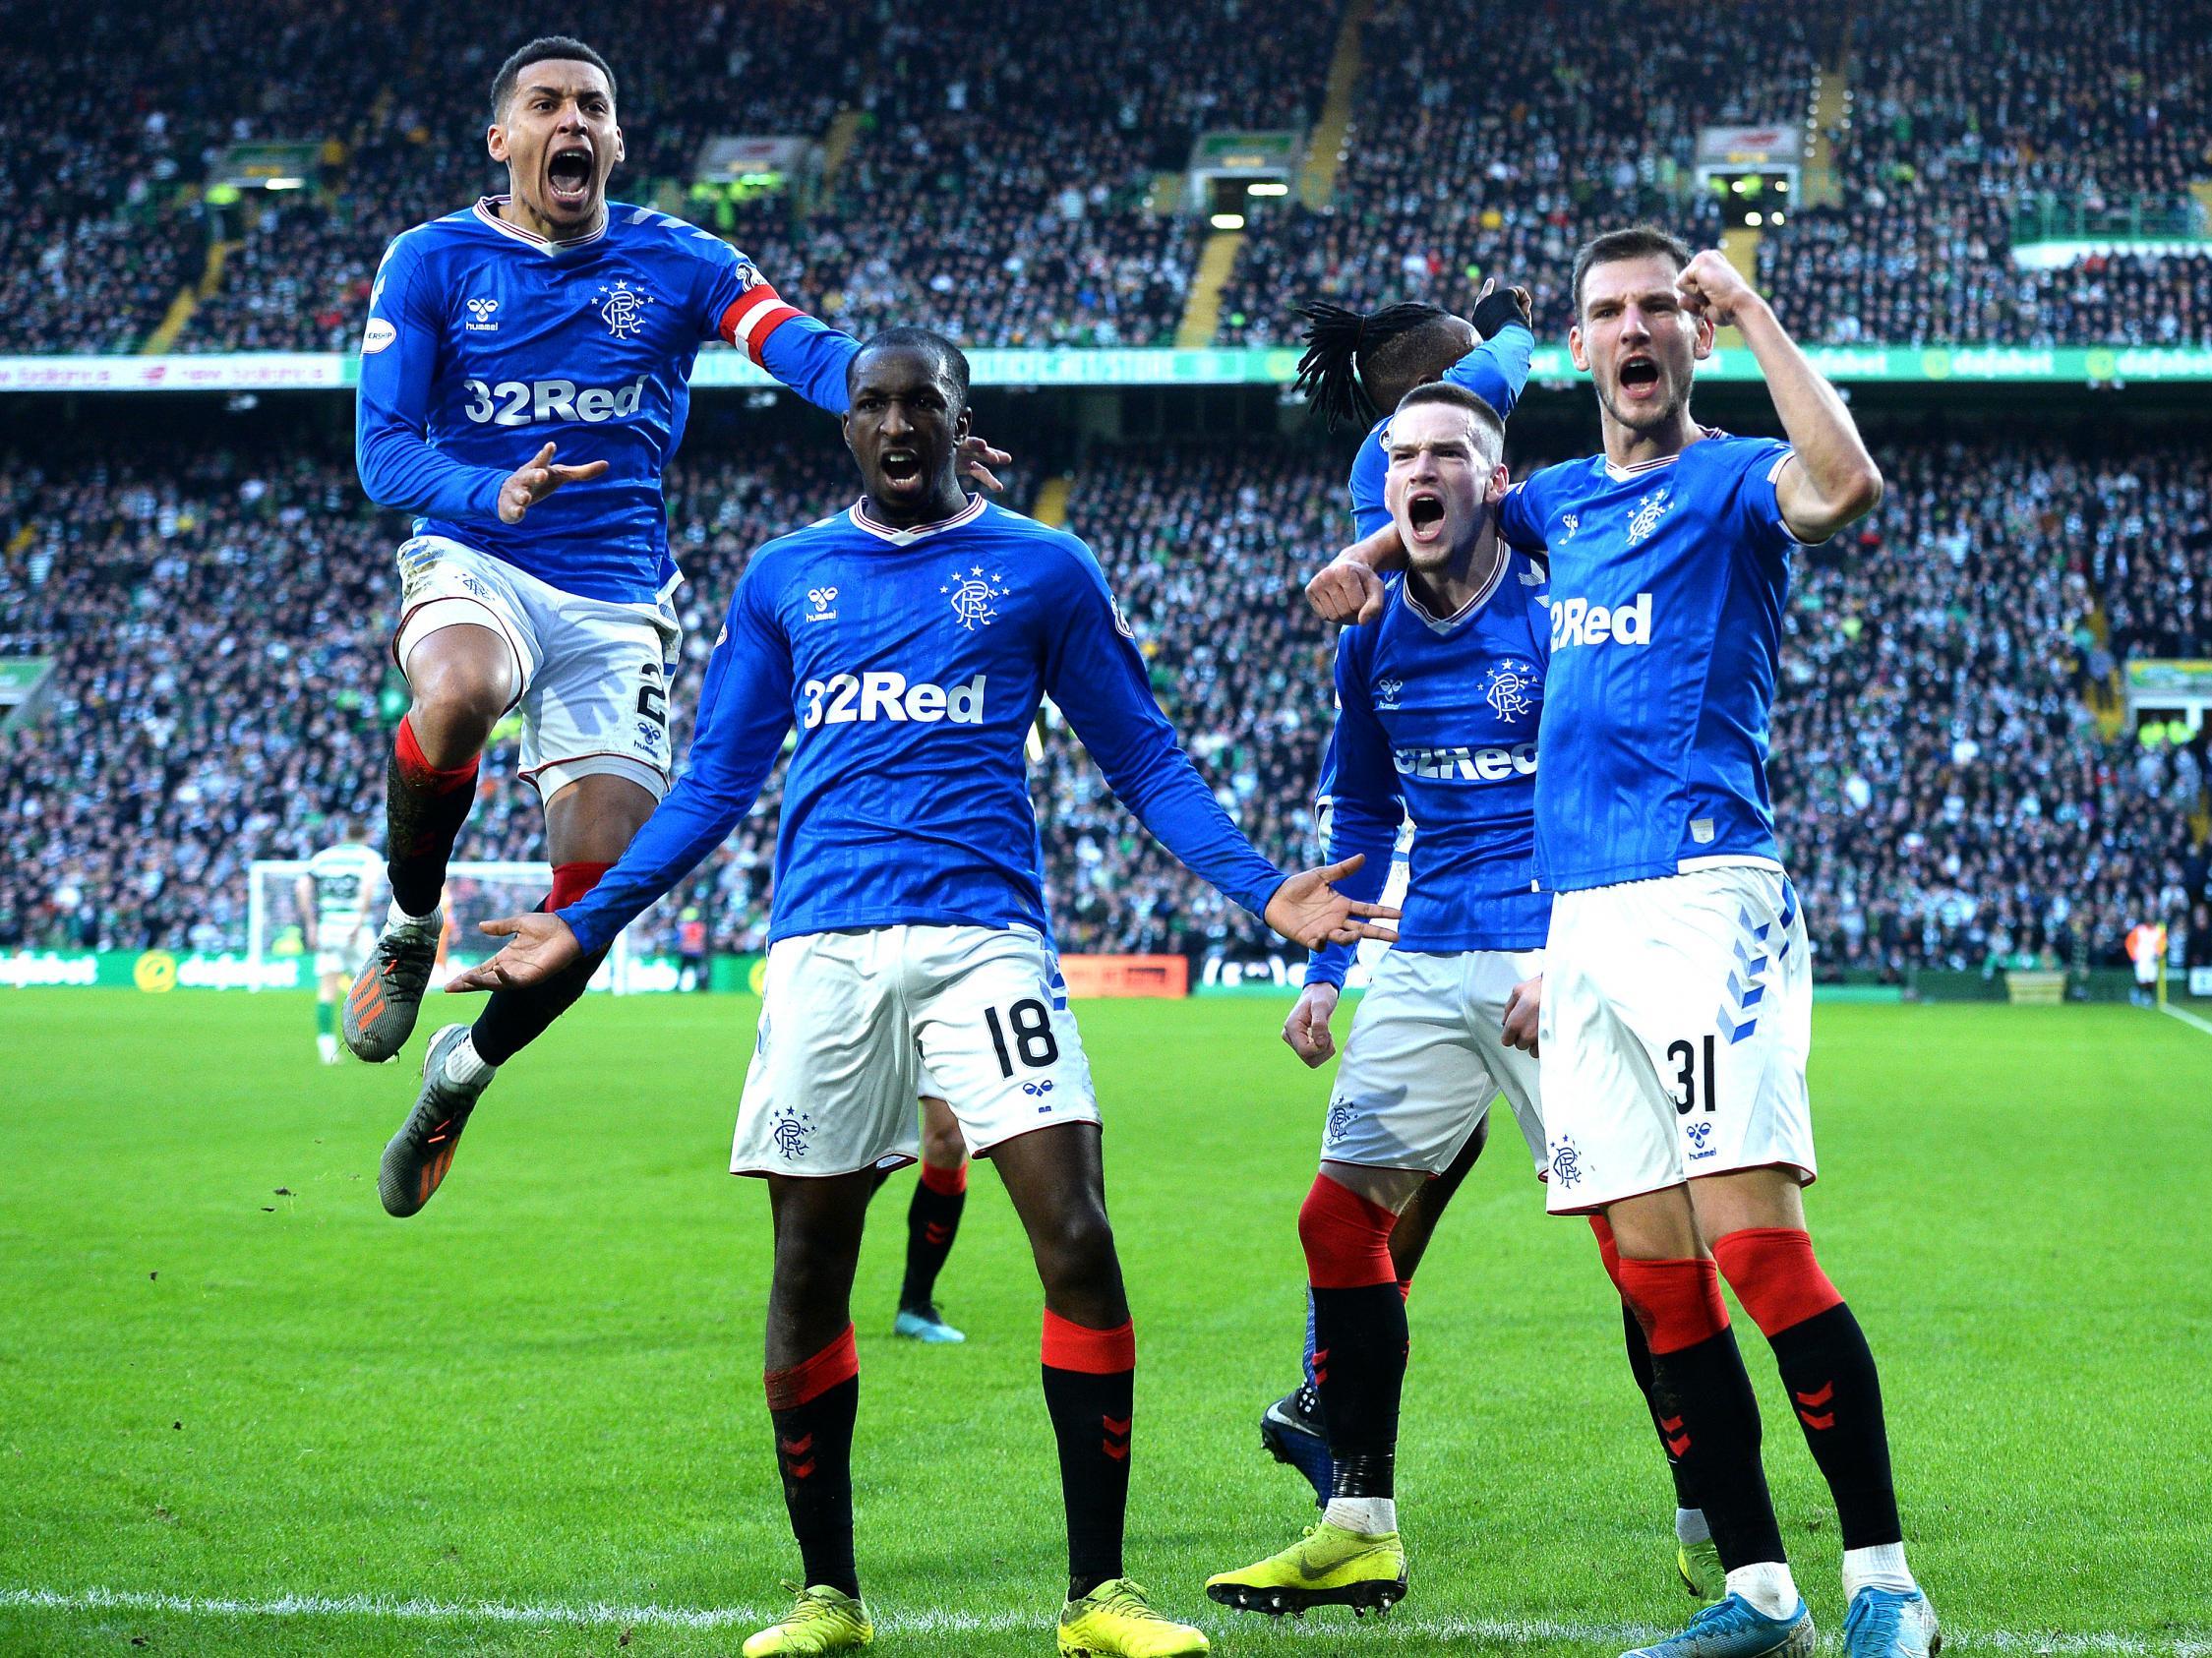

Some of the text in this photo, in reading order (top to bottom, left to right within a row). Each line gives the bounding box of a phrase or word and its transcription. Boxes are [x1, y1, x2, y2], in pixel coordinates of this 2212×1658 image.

[366, 331, 392, 340] ERSHIP
[465, 322, 499, 331] hummel
[2115, 348, 2212, 378] dafabe
[463, 375, 649, 427] 32Red
[806, 609, 837, 623] hummel
[1550, 593, 1652, 654] 2Red
[636, 663, 666, 728] 2
[804, 672, 987, 730] 32Red
[985, 998, 1059, 1079] 18
[1667, 1035, 1716, 1115] 31
